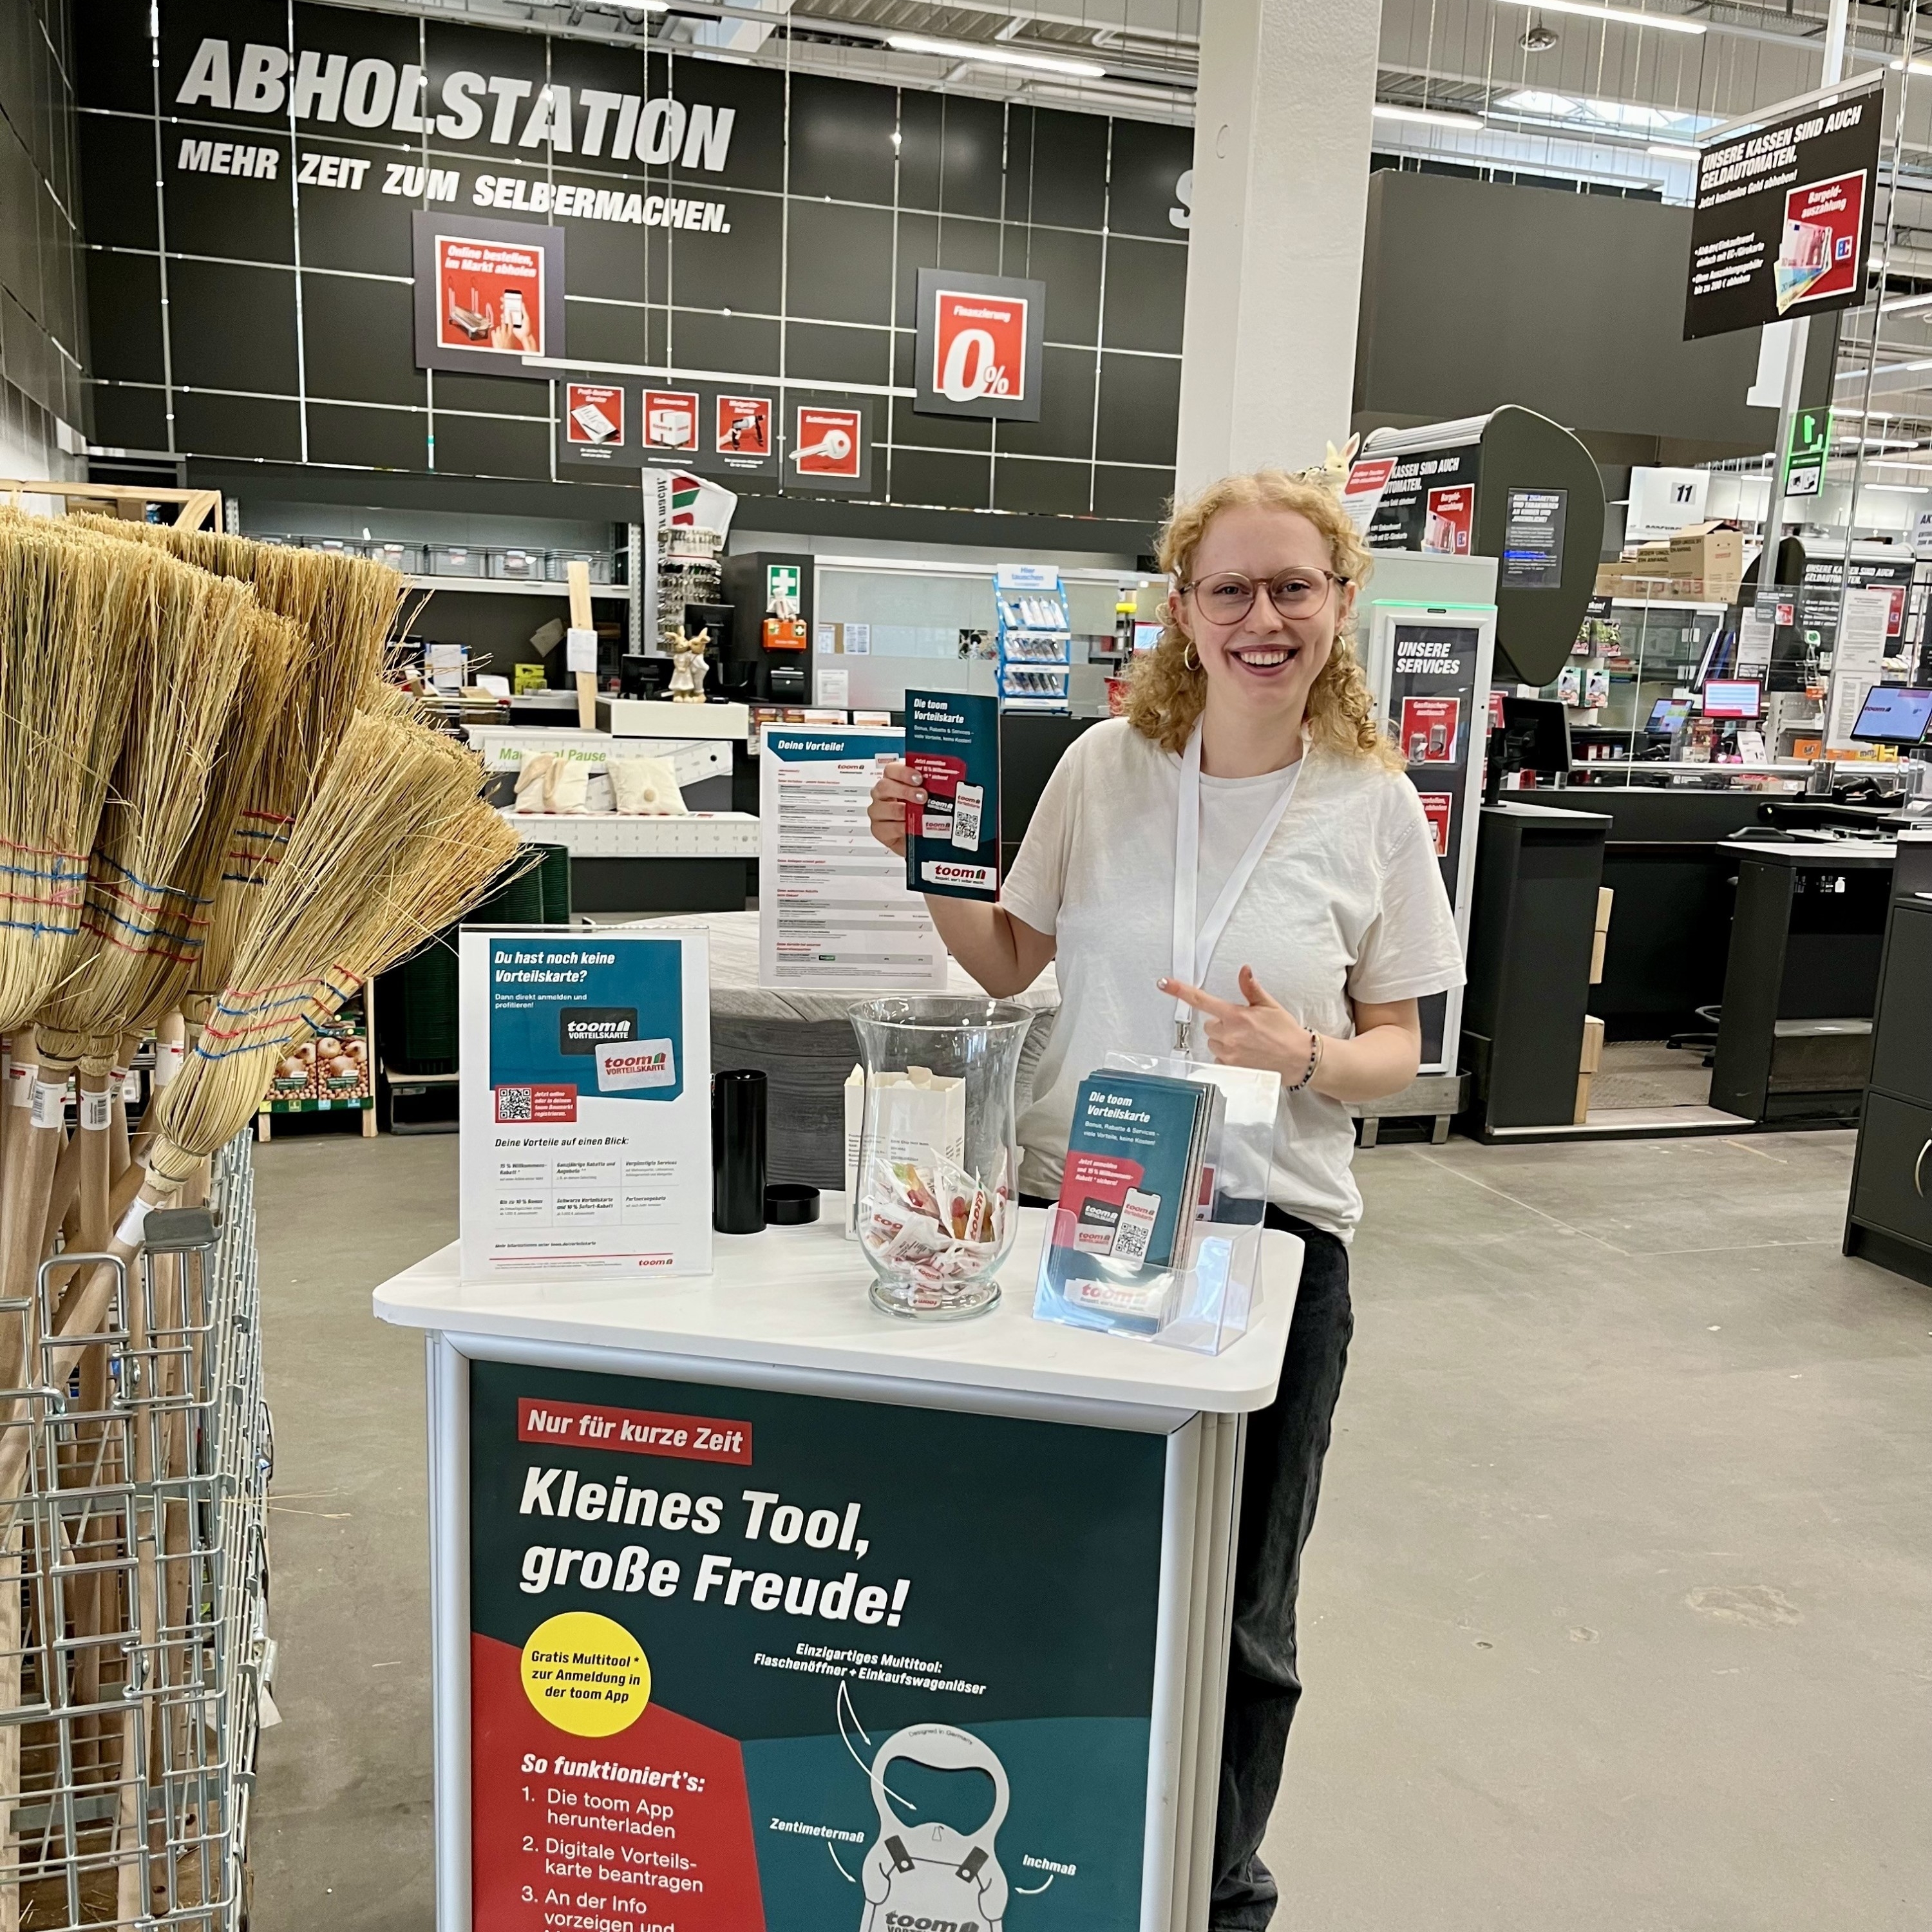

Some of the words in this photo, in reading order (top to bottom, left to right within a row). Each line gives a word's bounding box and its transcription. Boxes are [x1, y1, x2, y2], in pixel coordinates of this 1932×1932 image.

[176, 38, 735, 172] ABHOLSTATION
[1702, 142, 1744, 173] UNSERE
[1745, 126, 1793, 159] KASSEN
[1794, 119, 1823, 143] SIND
[1824, 105, 1862, 134] AUCH
[1700, 145, 1797, 191] GELDAUTOMATEN.
[178, 139, 278, 180] MEHR
[298, 153, 371, 191] ZEIT
[383, 163, 460, 202] ZUM
[473, 175, 731, 234] SELBERMACHEN.
[1808, 185, 1842, 204] Bargeld-
[1698, 193, 1714, 209] Jetzt
[1801, 198, 1846, 218] auszahlung
[448, 245, 482, 259] Online
[483, 249, 533, 267] bestellen,
[461, 260, 493, 272] Markt
[495, 264, 536, 278] abholen
[954, 305, 1011, 323] Finanzierung
[1419, 460, 1437, 475] SIND
[1437, 457, 1460, 473] AUCH
[1677, 485, 1693, 502] 11
[1397, 641, 1452, 658] UNSERE
[1396, 657, 1461, 674] SERVICES
[914, 698, 926, 708] Die
[927, 699, 948, 710] toom
[914, 710, 965, 724] Vorteilskarte
[568, 749, 606, 761] Pause
[778, 740, 804, 750] Deine
[806, 741, 845, 752] Vorteile!
[927, 799, 947, 809] toom
[958, 795, 976, 804] toom
[935, 864, 975, 878] toom
[495, 951, 512, 964] Du
[515, 951, 544, 964] hast
[547, 951, 578, 964] noch
[580, 951, 615, 965] keine
[495, 969, 588, 983] Vorteilskarte?
[567, 1020, 616, 1032] toom
[604, 1055, 652, 1068] toom
[606, 1064, 665, 1075] VORTEILSKARTE
[1089, 1092, 1105, 1103] Die
[1107, 1094, 1132, 1106] toom
[1087, 1104, 1150, 1122] Vorteilskarte
[1097, 1132, 1118, 1141] Vorteile,
[1132, 1128, 1155, 1136] Services
[495, 1139, 520, 1147] Deine
[524, 1138, 558, 1146] Vorteile
[561, 1138, 576, 1146] auf
[578, 1137, 603, 1146] einen
[605, 1137, 629, 1145] Blick:
[1085, 1206, 1110, 1217] toom
[1126, 1204, 1148, 1213] toom
[1082, 1283, 1133, 1302] toom
[526, 1408, 573, 1435] Nur
[580, 1414, 616, 1441] für
[620, 1419, 688, 1447] kurze
[693, 1425, 744, 1453] Zeit
[518, 1466, 724, 1535] Kleines
[741, 1490, 869, 1560] Tool,
[519, 1545, 681, 1598] große
[693, 1553, 911, 1628] Freude!
[531, 1650, 569, 1665] Gratis
[572, 1653, 631, 1667] Multitool
[795, 1643, 878, 1665] Einzigartiges
[880, 1653, 943, 1674] Multitool:
[531, 1669, 553, 1680] zur
[555, 1669, 625, 1687] Anmeldung
[629, 1674, 641, 1685] in
[753, 1653, 848, 1676] Flaschenöffner
[858, 1667, 986, 1695] Einkaufswagenlöser
[545, 1686, 567, 1698] der
[569, 1689, 602, 1700] toom
[605, 1689, 629, 1704] App
[909, 1728, 937, 1737] Designed
[946, 1730, 972, 1745] Germany
[521, 1753, 548, 1775] So
[554, 1755, 705, 1793] funktioniert's:
[522, 1786, 535, 1802] 1.
[547, 1788, 577, 1805] Die
[583, 1793, 630, 1813] toom
[636, 1799, 674, 1819] App
[547, 1810, 676, 1839] herunterladen
[770, 1818, 865, 1843] Zentimetermaß
[522, 1835, 539, 1852] 2.
[546, 1837, 615, 1861] Digitale
[620, 1846, 697, 1870] Vorteils-
[1022, 1855, 1077, 1875] Inchmaß
[545, 1859, 592, 1879] karte
[599, 1866, 703, 1893] beantragen
[522, 1886, 538, 1902] 3.
[545, 1889, 571, 1906] An
[576, 1890, 607, 1911] der
[612, 1895, 647, 1914] Info
[545, 1913, 634, 1932] vorzeigen
[886, 1909, 958, 1932] toom
